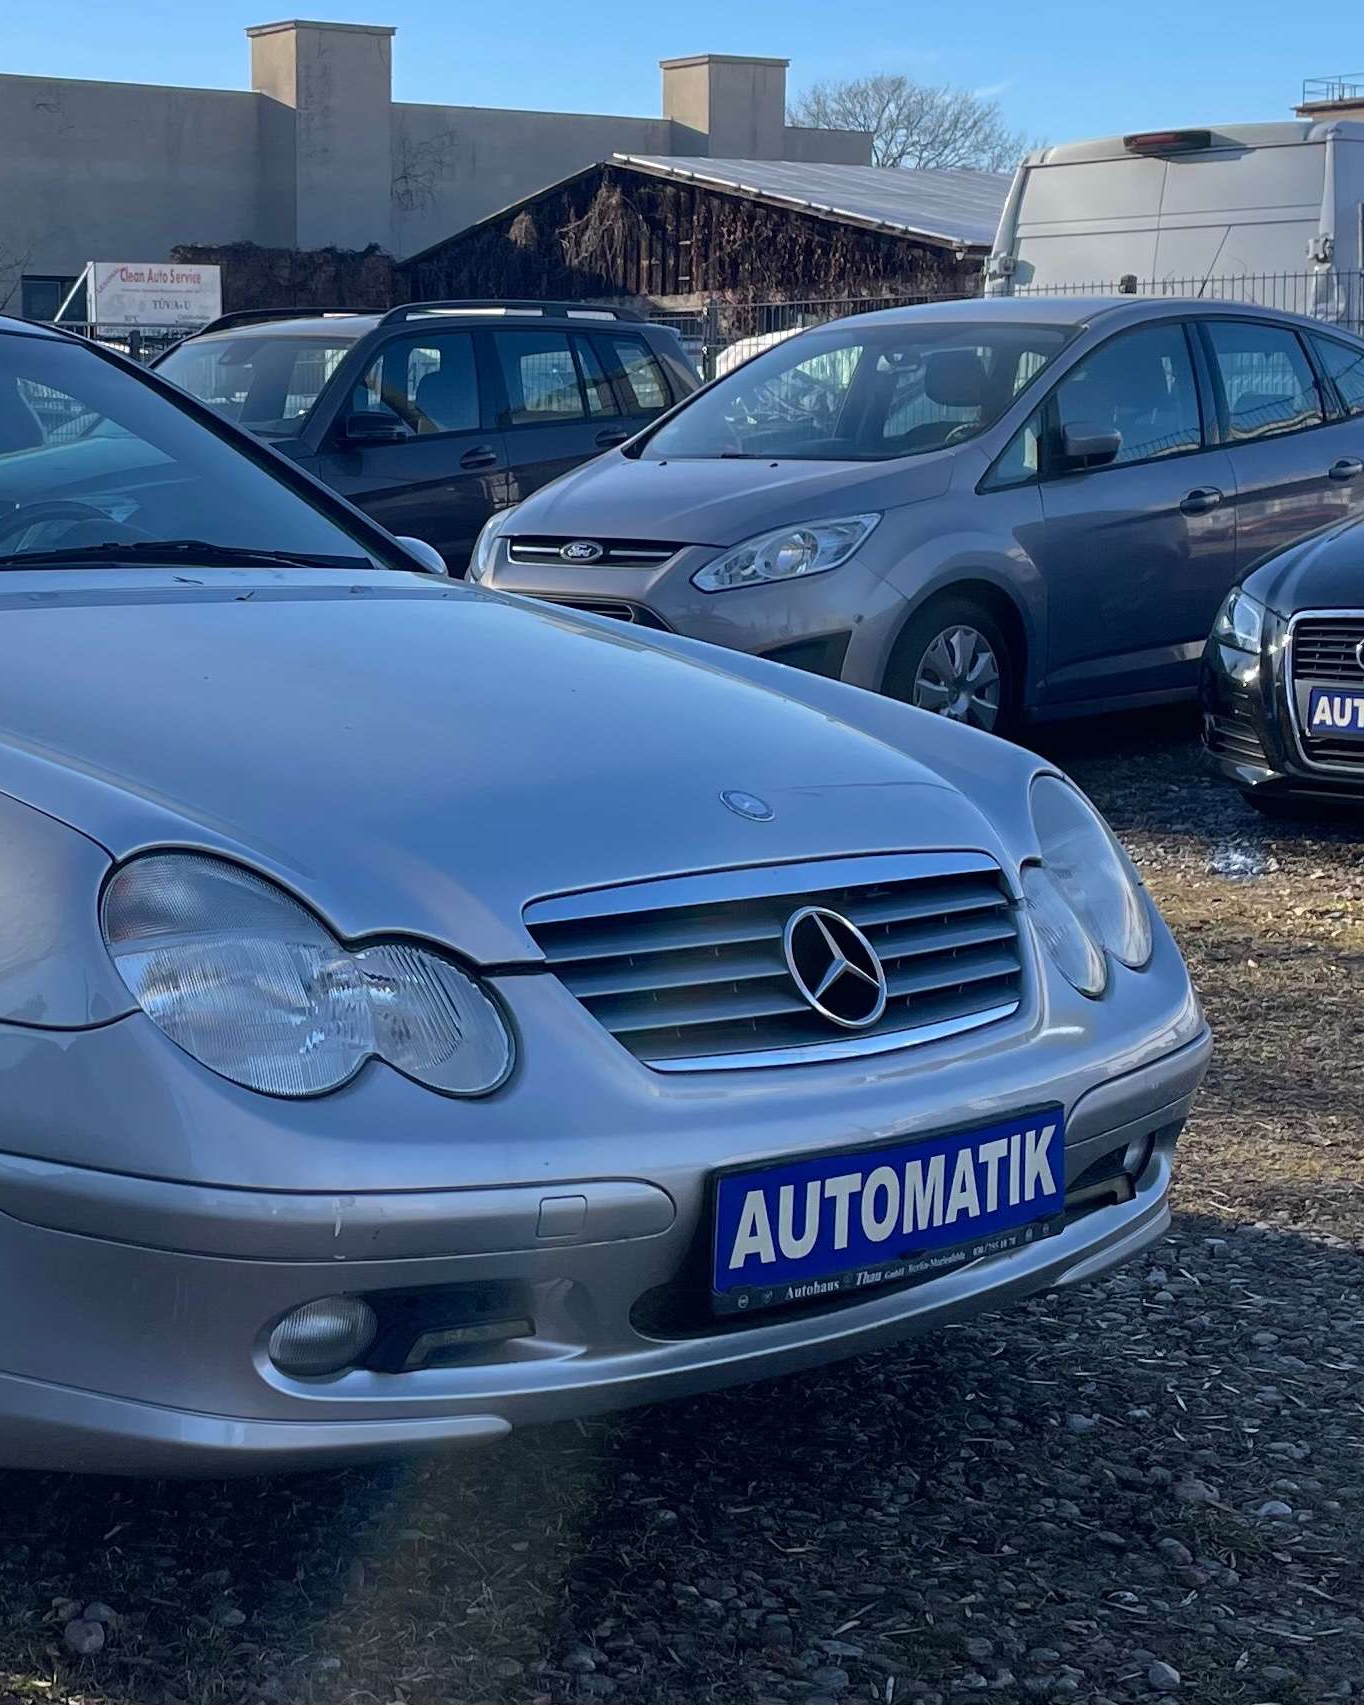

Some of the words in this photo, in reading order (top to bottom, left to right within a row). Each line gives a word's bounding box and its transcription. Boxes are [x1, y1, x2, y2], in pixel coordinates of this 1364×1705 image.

[120, 267, 145, 283] Clean
[147, 268, 168, 283] Auto
[170, 268, 202, 285] Service
[729, 1125, 1057, 1270] AUTOMATIK
[786, 1281, 840, 1300] Autohaus
